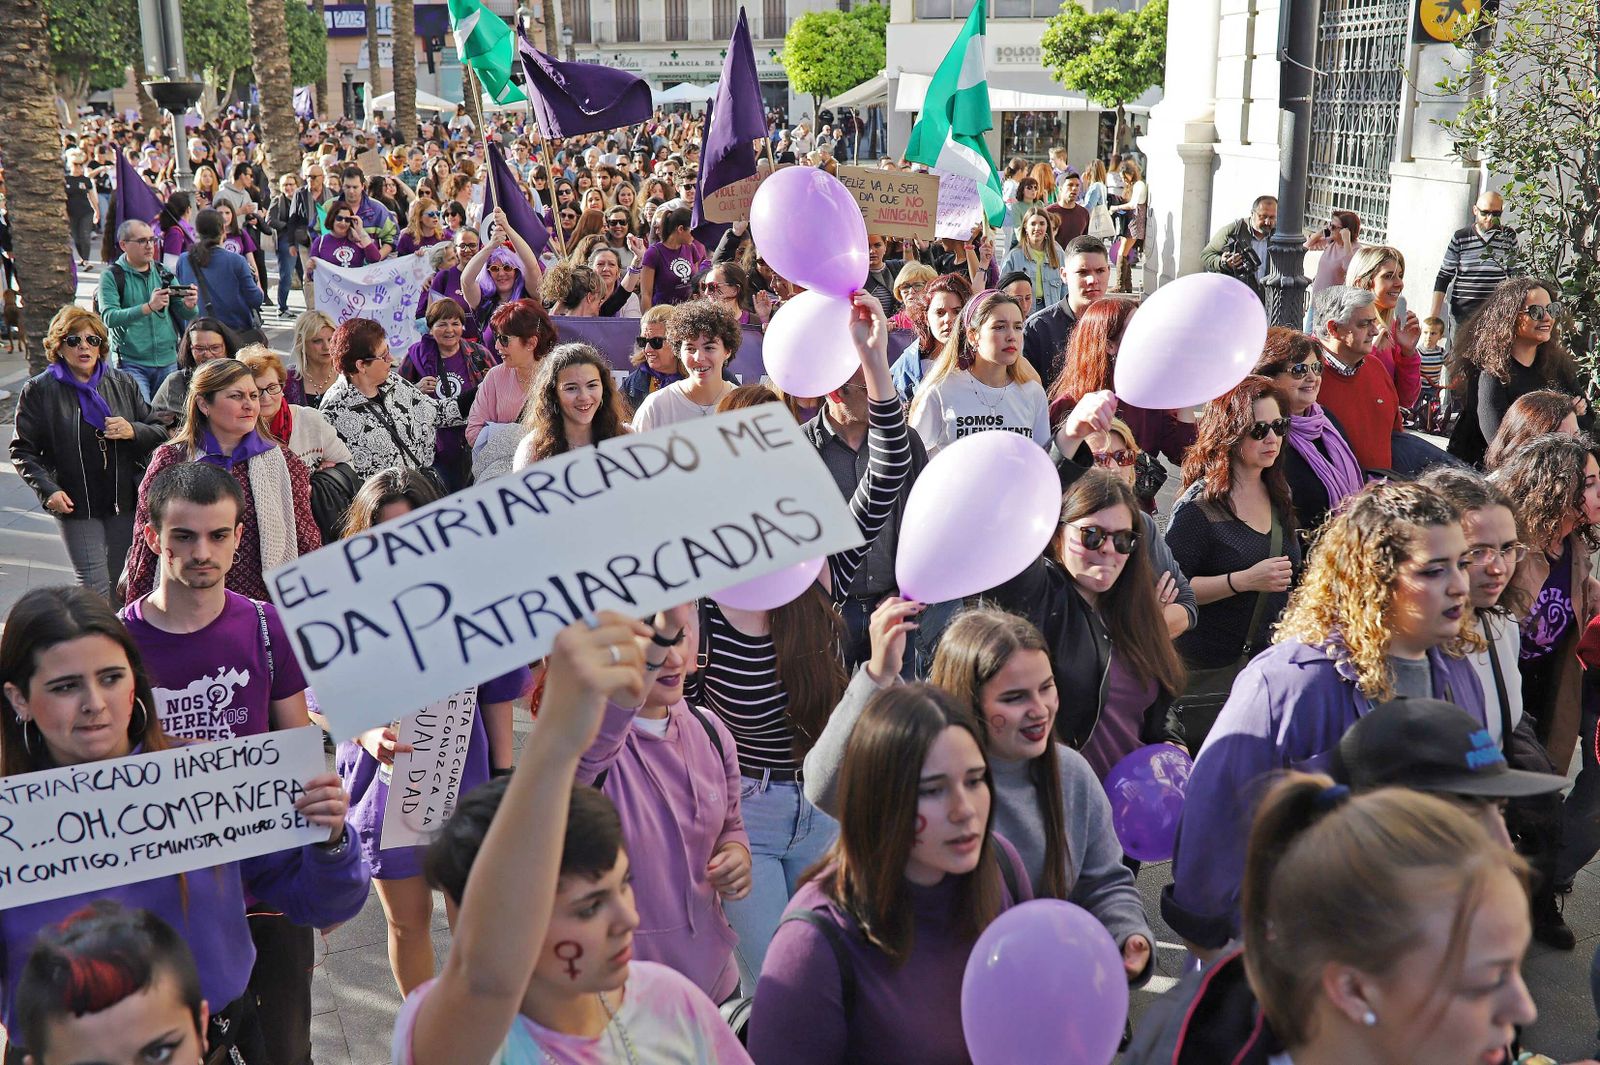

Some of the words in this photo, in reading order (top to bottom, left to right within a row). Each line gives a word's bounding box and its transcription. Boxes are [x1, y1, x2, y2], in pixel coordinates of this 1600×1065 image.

[871, 180, 882, 191] VA
[887, 182, 894, 193] A
[898, 183, 919, 195] SER
[880, 193, 900, 205] QUE
[905, 196, 925, 208] NO
[956, 414, 1004, 427] SOMOS
[274, 566, 330, 610] EL
[342, 429, 700, 584] PATRIARCADO
[716, 411, 793, 458] ME
[295, 609, 391, 672] DA
[391, 496, 823, 673] PATRIARCADAS
[166, 694, 204, 715] NOS
[160, 706, 249, 733] UEREMOS
[430, 692, 460, 795] ECONOZCA
[0, 760, 161, 804] ATRIARCADO
[174, 739, 280, 780] HAREMOS
[118, 779, 307, 834] COMPAÑERA
[422, 806, 436, 826] LA
[130, 832, 223, 862] FEMINISTA
